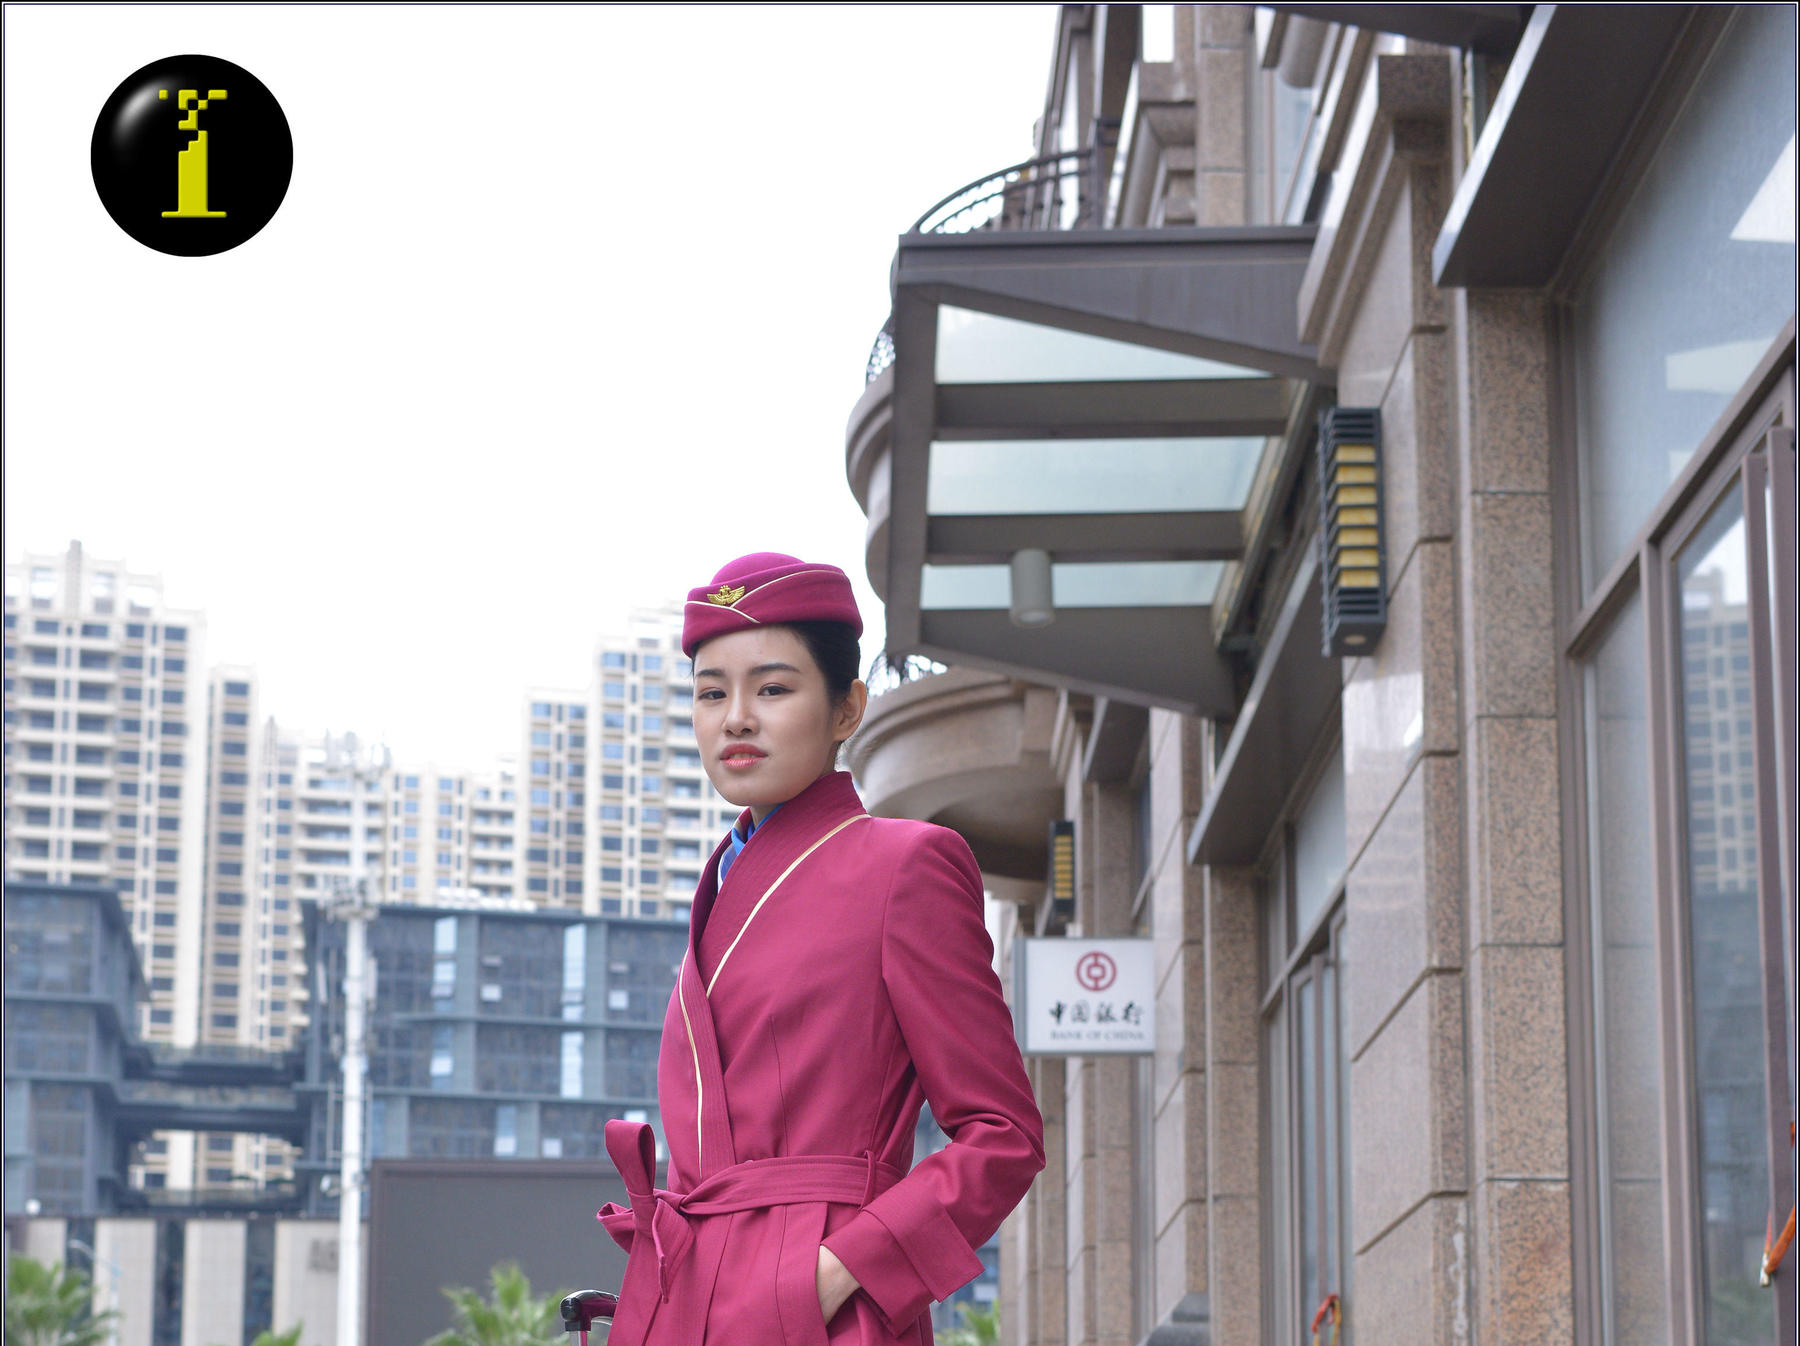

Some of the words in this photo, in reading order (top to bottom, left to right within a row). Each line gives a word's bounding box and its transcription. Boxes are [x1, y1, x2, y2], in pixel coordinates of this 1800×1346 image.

[1049, 999, 1144, 1025] 中国银行
[1050, 1030, 1082, 1040] BANK
[1086, 1030, 1101, 1040] OF
[1103, 1030, 1145, 1040] CHINA
